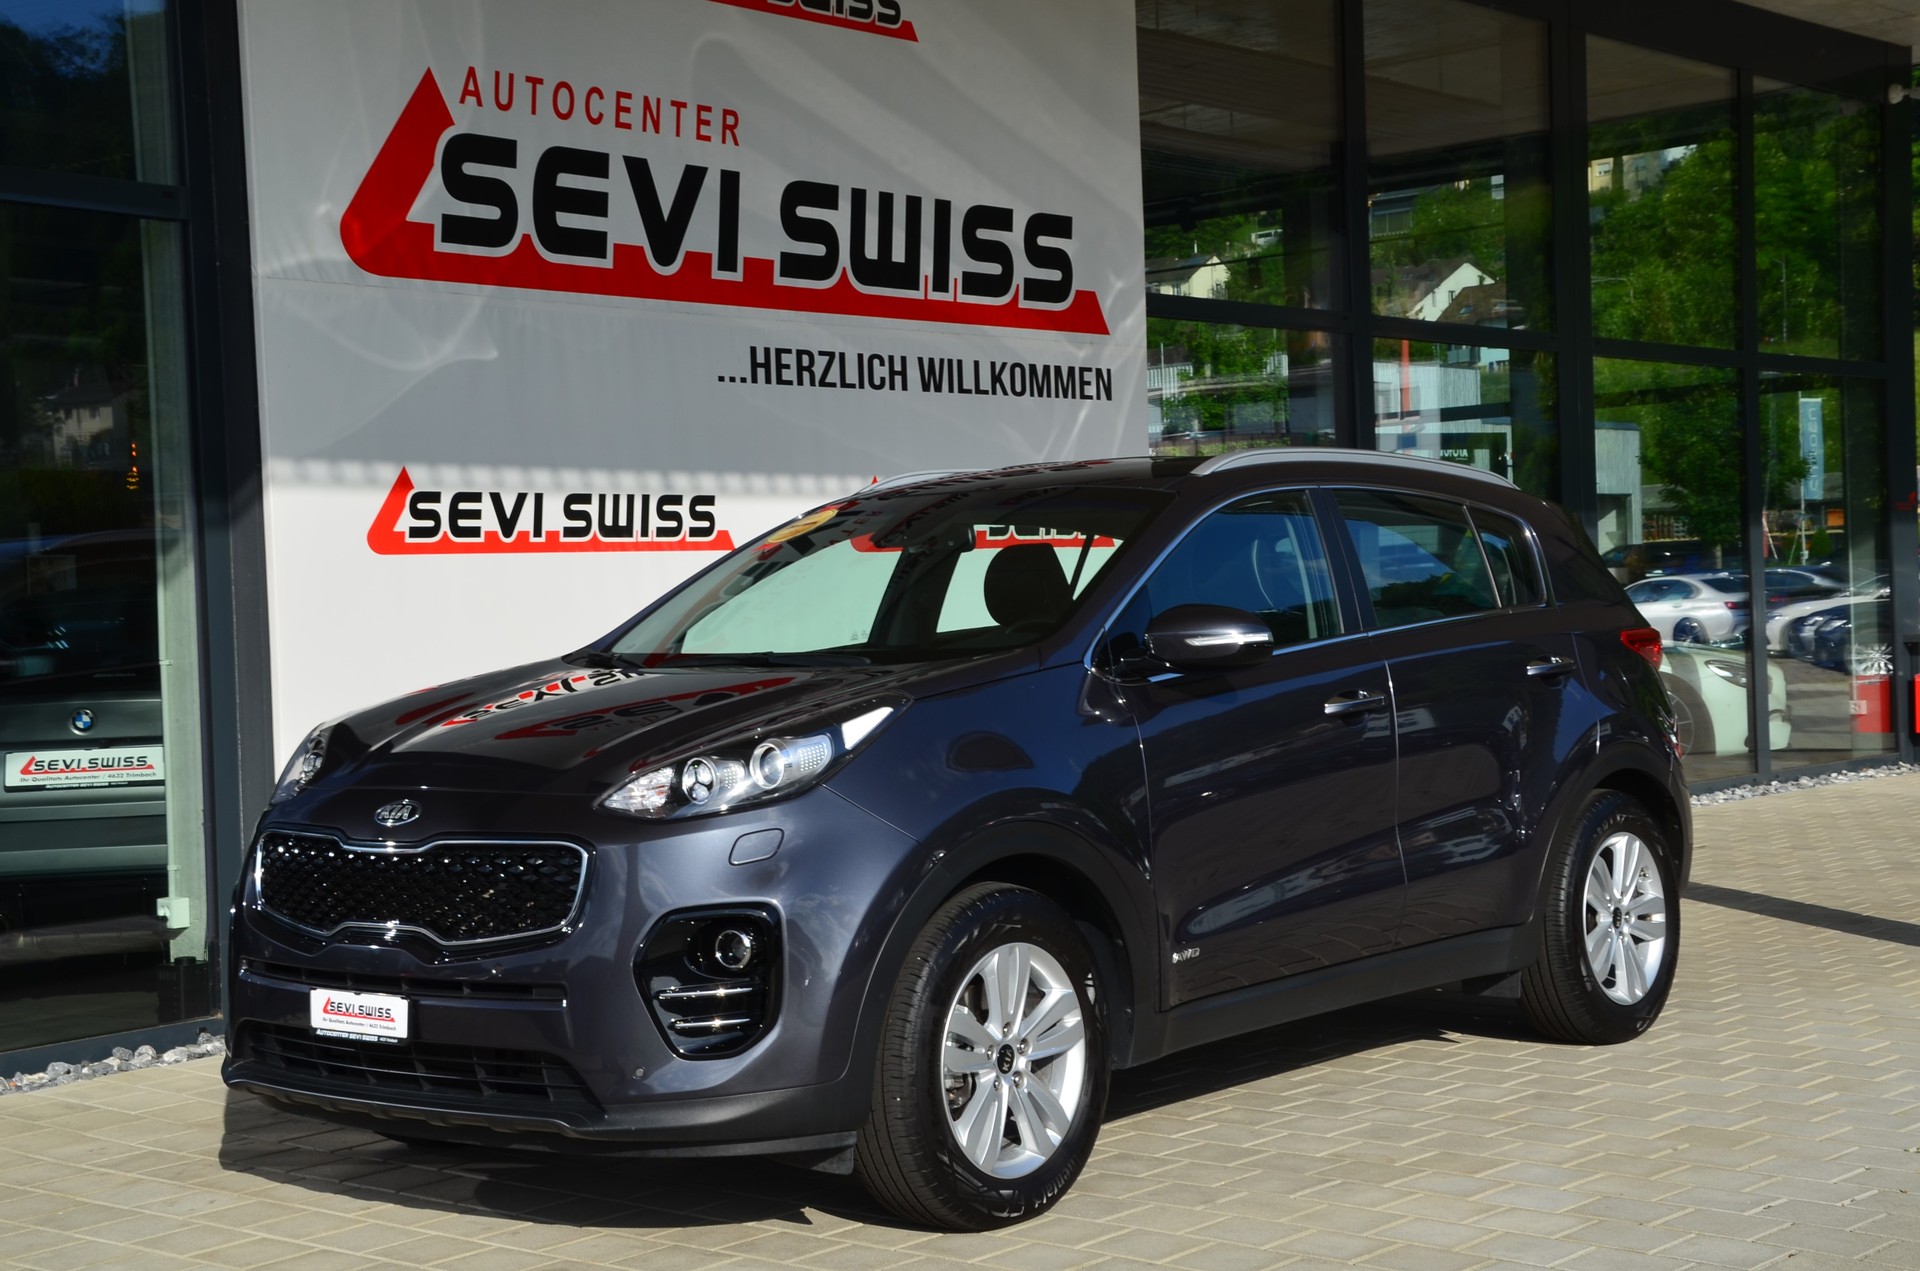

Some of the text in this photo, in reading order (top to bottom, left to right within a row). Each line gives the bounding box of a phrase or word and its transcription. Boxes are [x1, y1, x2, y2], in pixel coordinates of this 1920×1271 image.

[459, 65, 741, 147] AUTOCENTER
[440, 133, 1074, 304] SEVI SWISS
[916, 357, 1114, 402] WILLKOMMEN
[407, 491, 717, 540] SEVI SWISS
[34, 755, 148, 772] SEVI SWISS
[378, 804, 412, 820] KIA
[329, 1001, 392, 1019] SEVI SWISS
